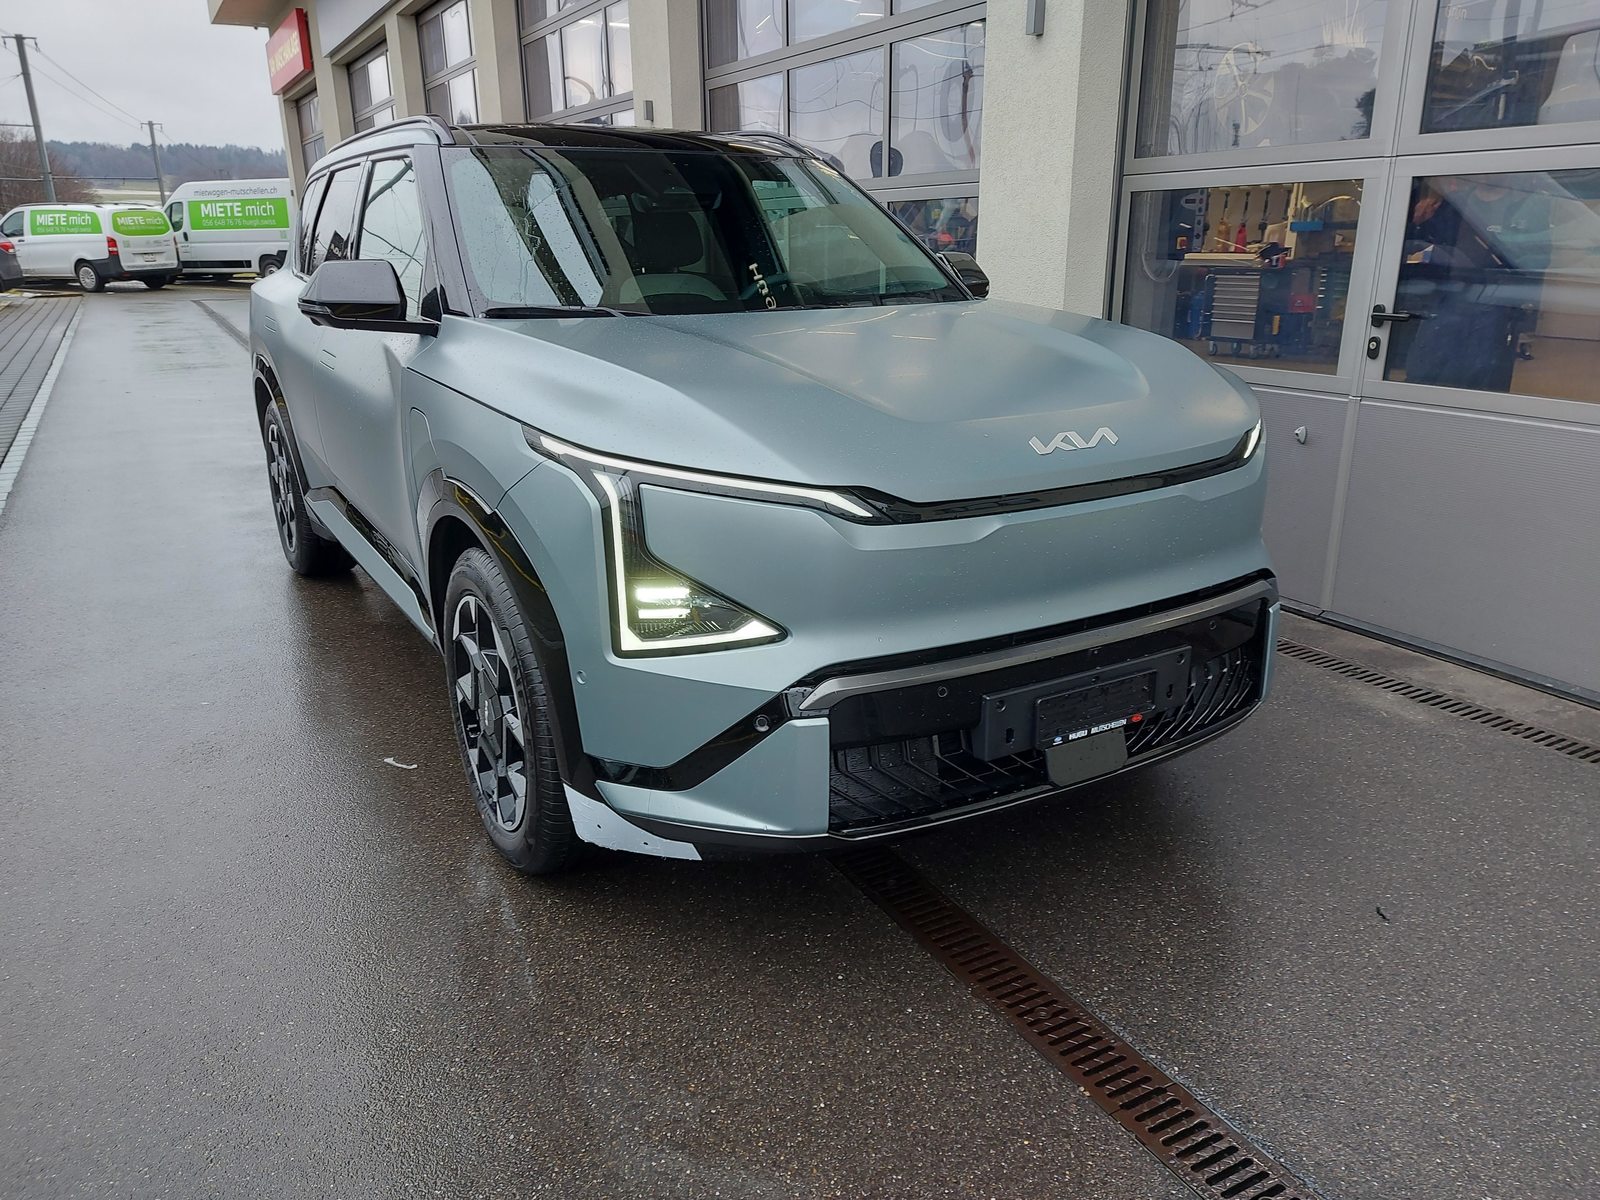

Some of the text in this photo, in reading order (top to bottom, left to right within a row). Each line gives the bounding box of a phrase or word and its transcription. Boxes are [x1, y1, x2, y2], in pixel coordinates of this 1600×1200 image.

[201, 202, 275, 217] MIETE mich
[36, 213, 92, 226] MIETE mich
[116, 216, 165, 225] MIETE mich
